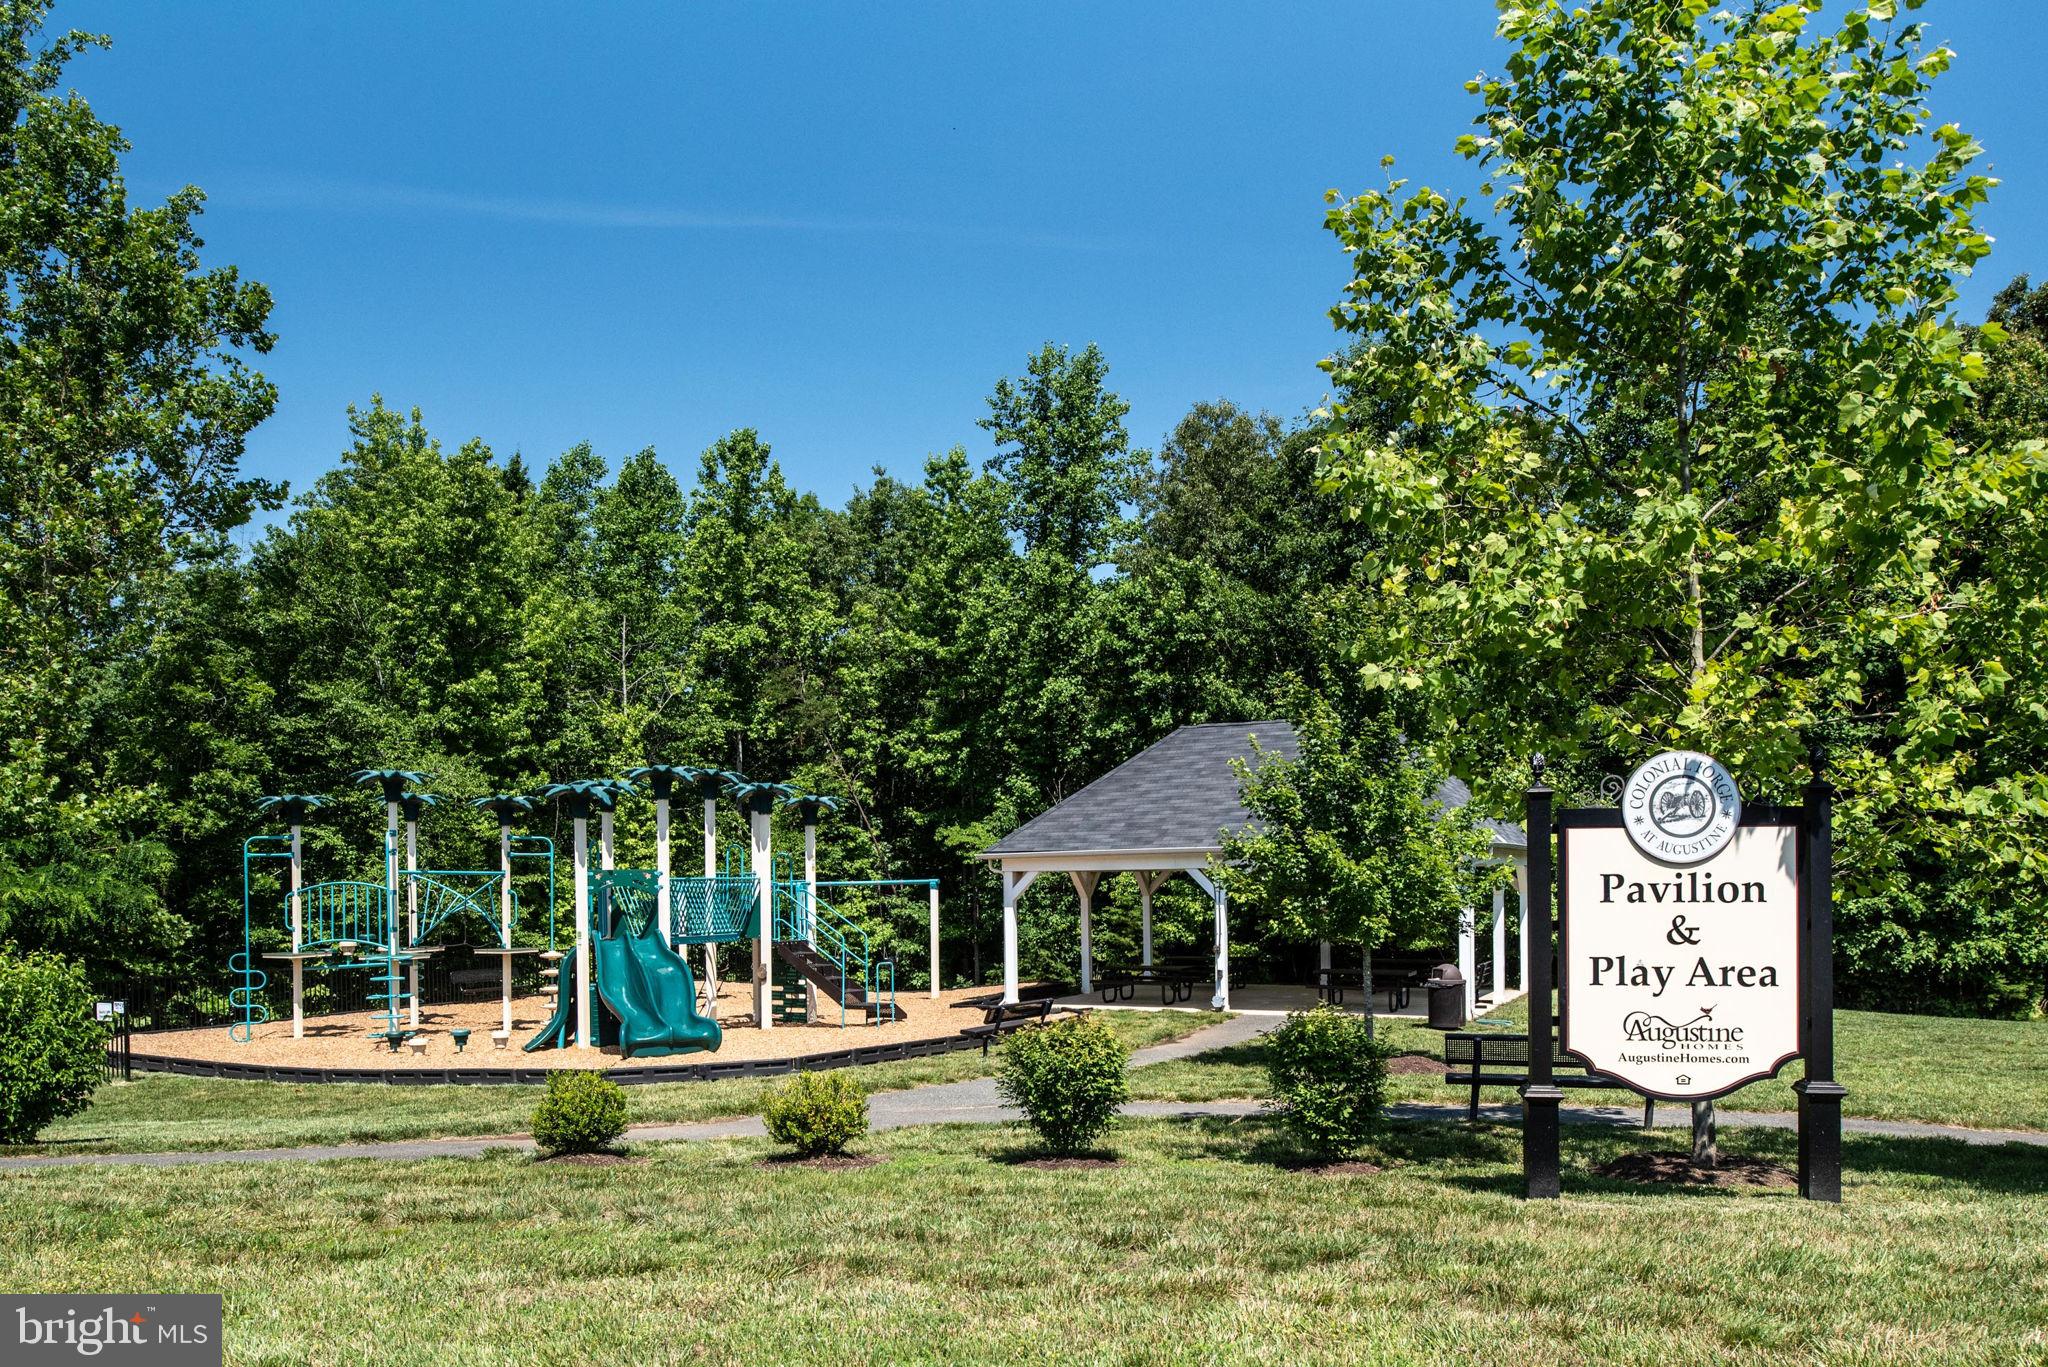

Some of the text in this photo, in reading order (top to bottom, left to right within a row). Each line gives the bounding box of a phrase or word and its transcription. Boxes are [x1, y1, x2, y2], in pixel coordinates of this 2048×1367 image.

[1630, 757, 1734, 809] COLONIAL FORGE
[1641, 823, 1728, 855] AT AUGUSTINE
[1599, 872, 1768, 904] Pavilion
[1665, 914, 1701, 946] &
[1588, 955, 1779, 997] Play Area
[1623, 1011, 1744, 1050] Augustine
[1617, 1052, 1750, 1066] AugustineHomes.com
[1681, 1043, 1744, 1051] HOMES
